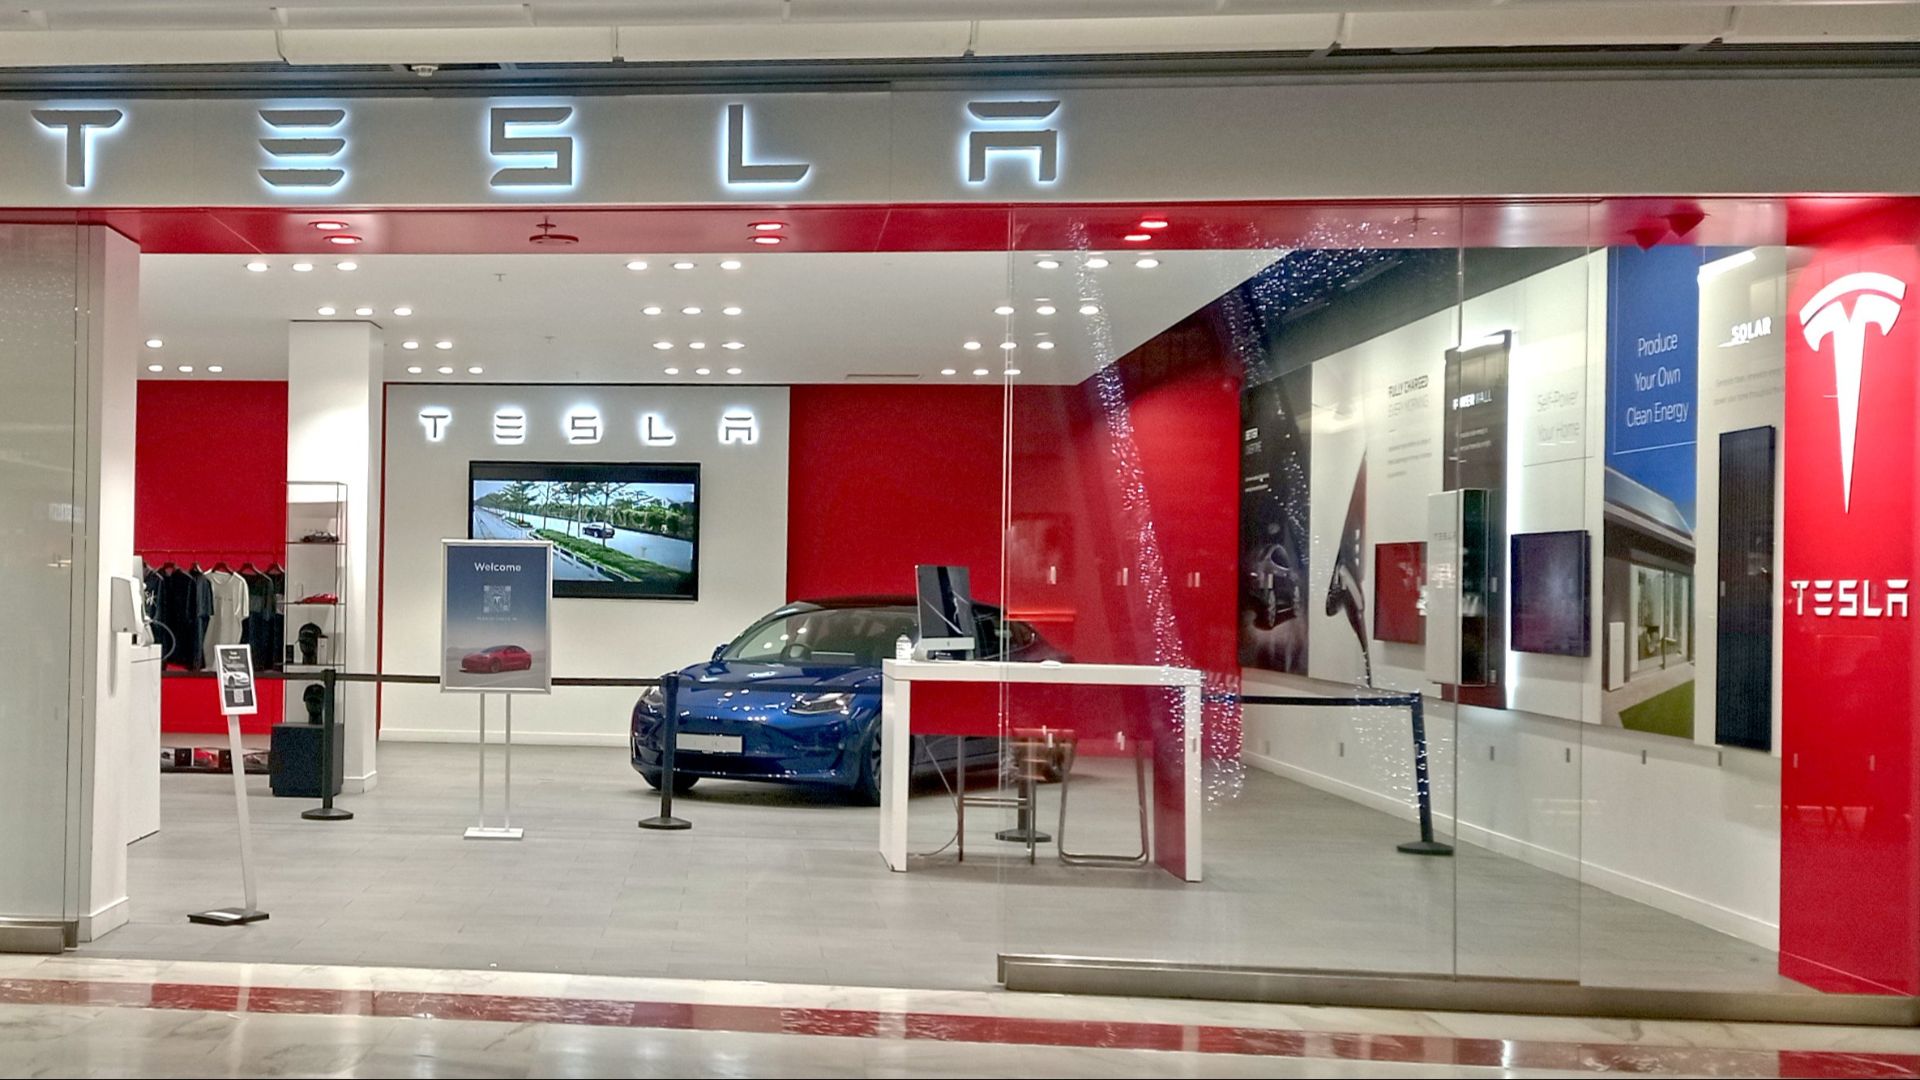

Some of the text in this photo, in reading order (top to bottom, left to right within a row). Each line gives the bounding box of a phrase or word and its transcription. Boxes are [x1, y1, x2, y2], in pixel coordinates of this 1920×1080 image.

[31, 101, 1061, 188] TESLA
[1730, 316, 1771, 342] SOLAR
[1638, 332, 1678, 357] Produce
[1634, 366, 1681, 392] Your Own
[420, 412, 756, 442] TESLA
[1626, 401, 1690, 428] Clean Energy
[474, 562, 522, 572] Welcome
[1790, 578, 1909, 618] TESLA
